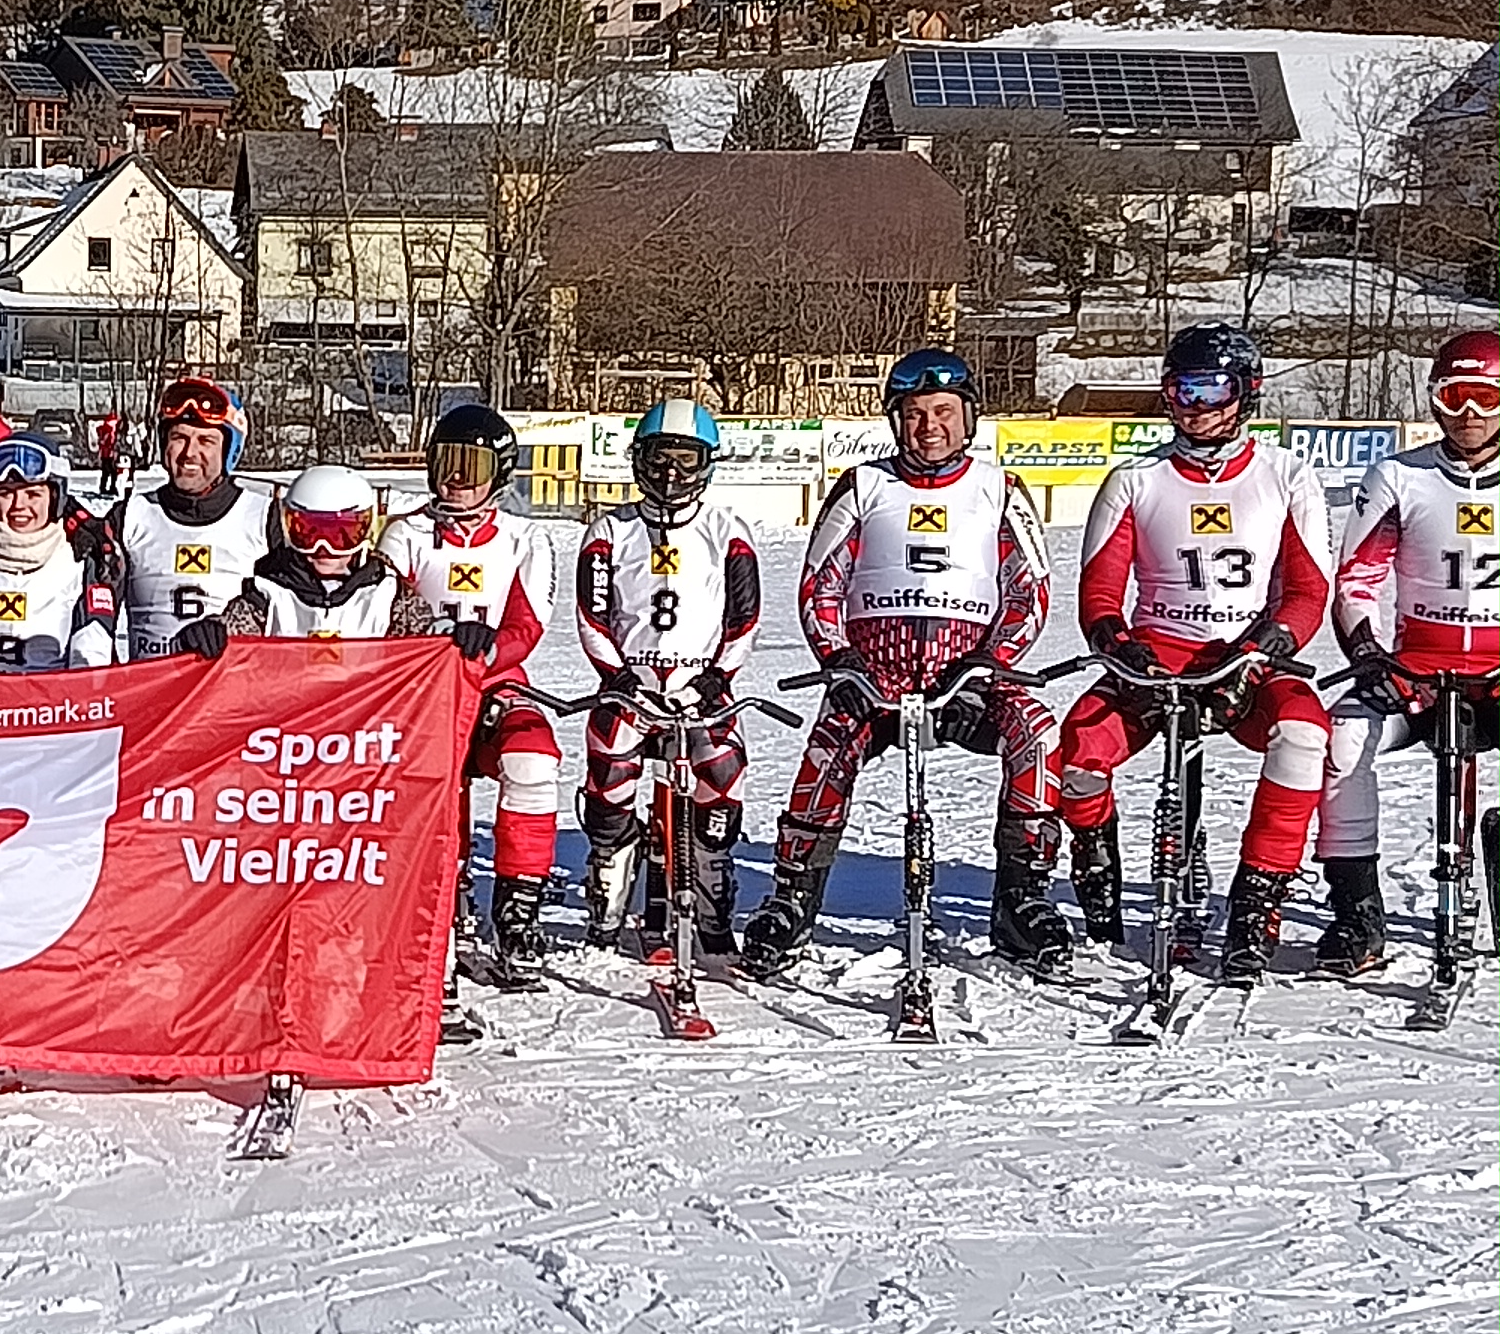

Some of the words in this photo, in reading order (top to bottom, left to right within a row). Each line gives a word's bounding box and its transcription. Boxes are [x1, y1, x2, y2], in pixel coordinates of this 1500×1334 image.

[1005, 442, 1104, 454] PAPST
[1291, 429, 1391, 467] BAUER
[906, 544, 951, 574] 5
[1177, 546, 1256, 591] 13
[1441, 549, 1500, 590] 12
[172, 584, 206, 620] 6
[651, 589, 679, 631] 8
[862, 588, 991, 616] Raiffeisen
[241, 722, 402, 775] Sport
[215, 778, 395, 824] seiner
[181, 837, 388, 885] Vielfalt
